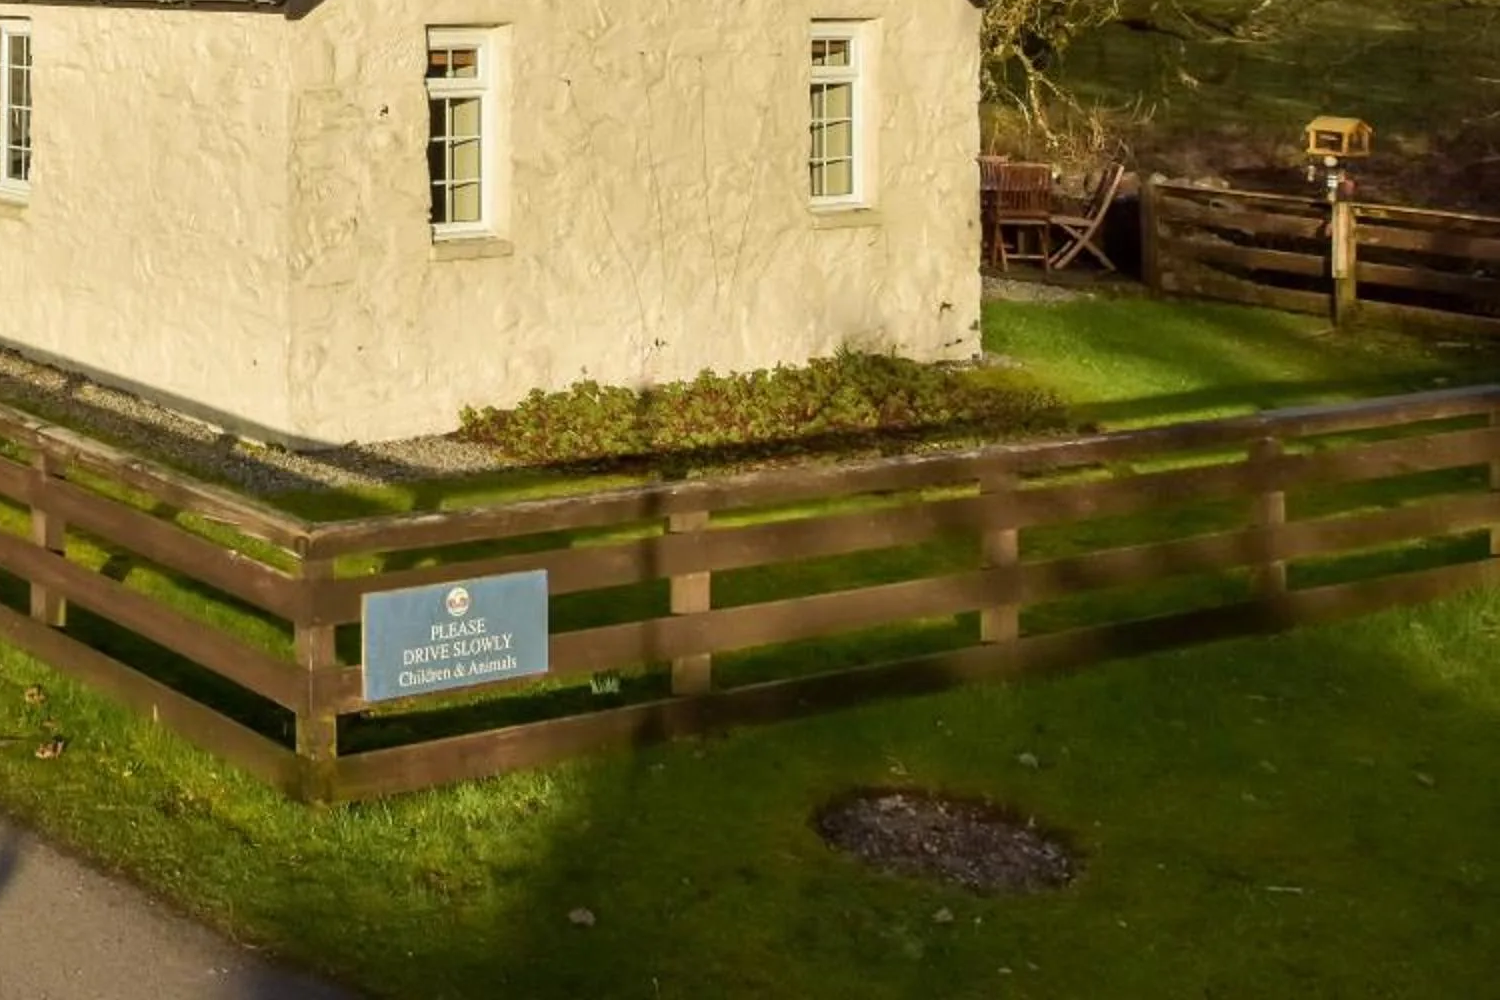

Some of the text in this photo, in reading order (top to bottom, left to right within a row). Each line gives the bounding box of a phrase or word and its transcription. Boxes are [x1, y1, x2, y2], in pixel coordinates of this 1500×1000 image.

[431, 618, 486, 640] PLEASE
[404, 633, 512, 665] DRIVE SLOWLY
[399, 655, 517, 687] Children & Animals
